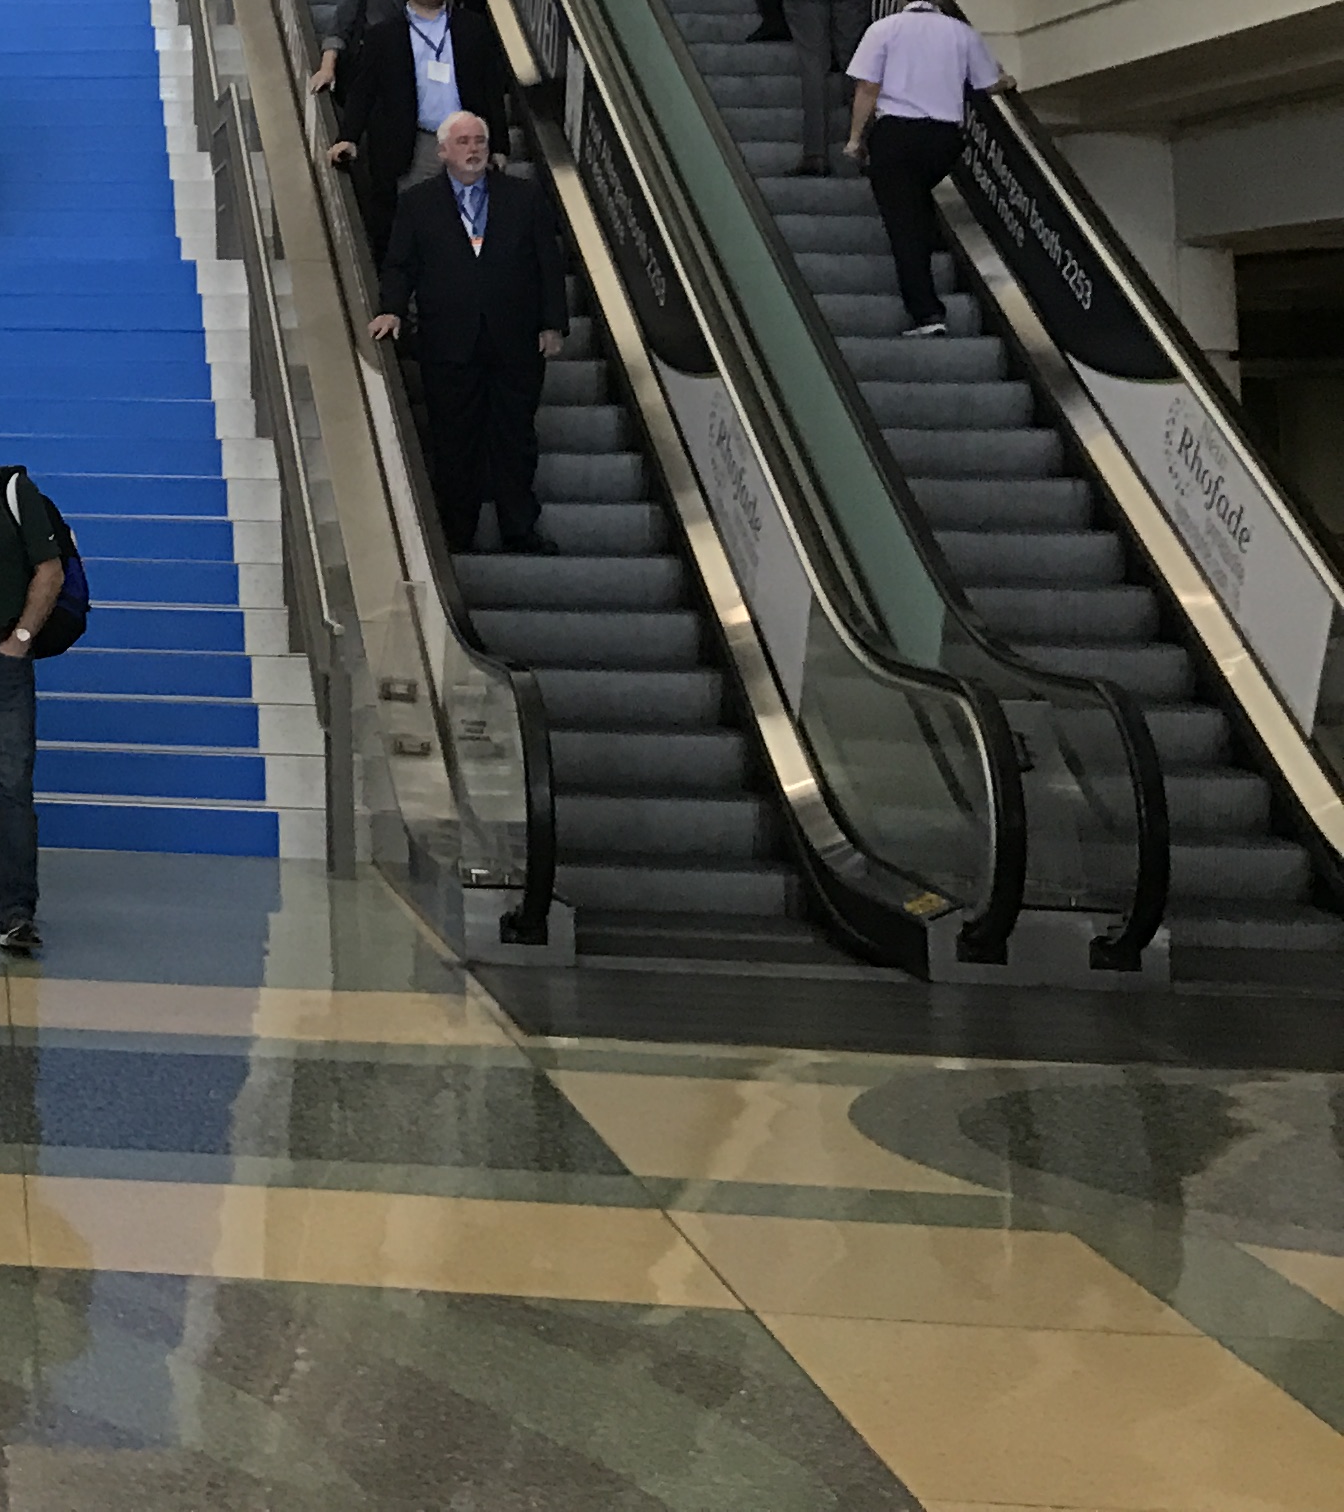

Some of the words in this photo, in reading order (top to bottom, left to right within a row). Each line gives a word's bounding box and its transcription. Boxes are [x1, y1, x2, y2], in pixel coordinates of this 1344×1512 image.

[971, 148, 998, 207] learn
[997, 197, 1025, 249] more
[987, 138, 1030, 218] Allergan
[1029, 198, 1062, 267] booth
[1061, 249, 1094, 311] 2253
[1177, 425, 1252, 554] Rhofade
